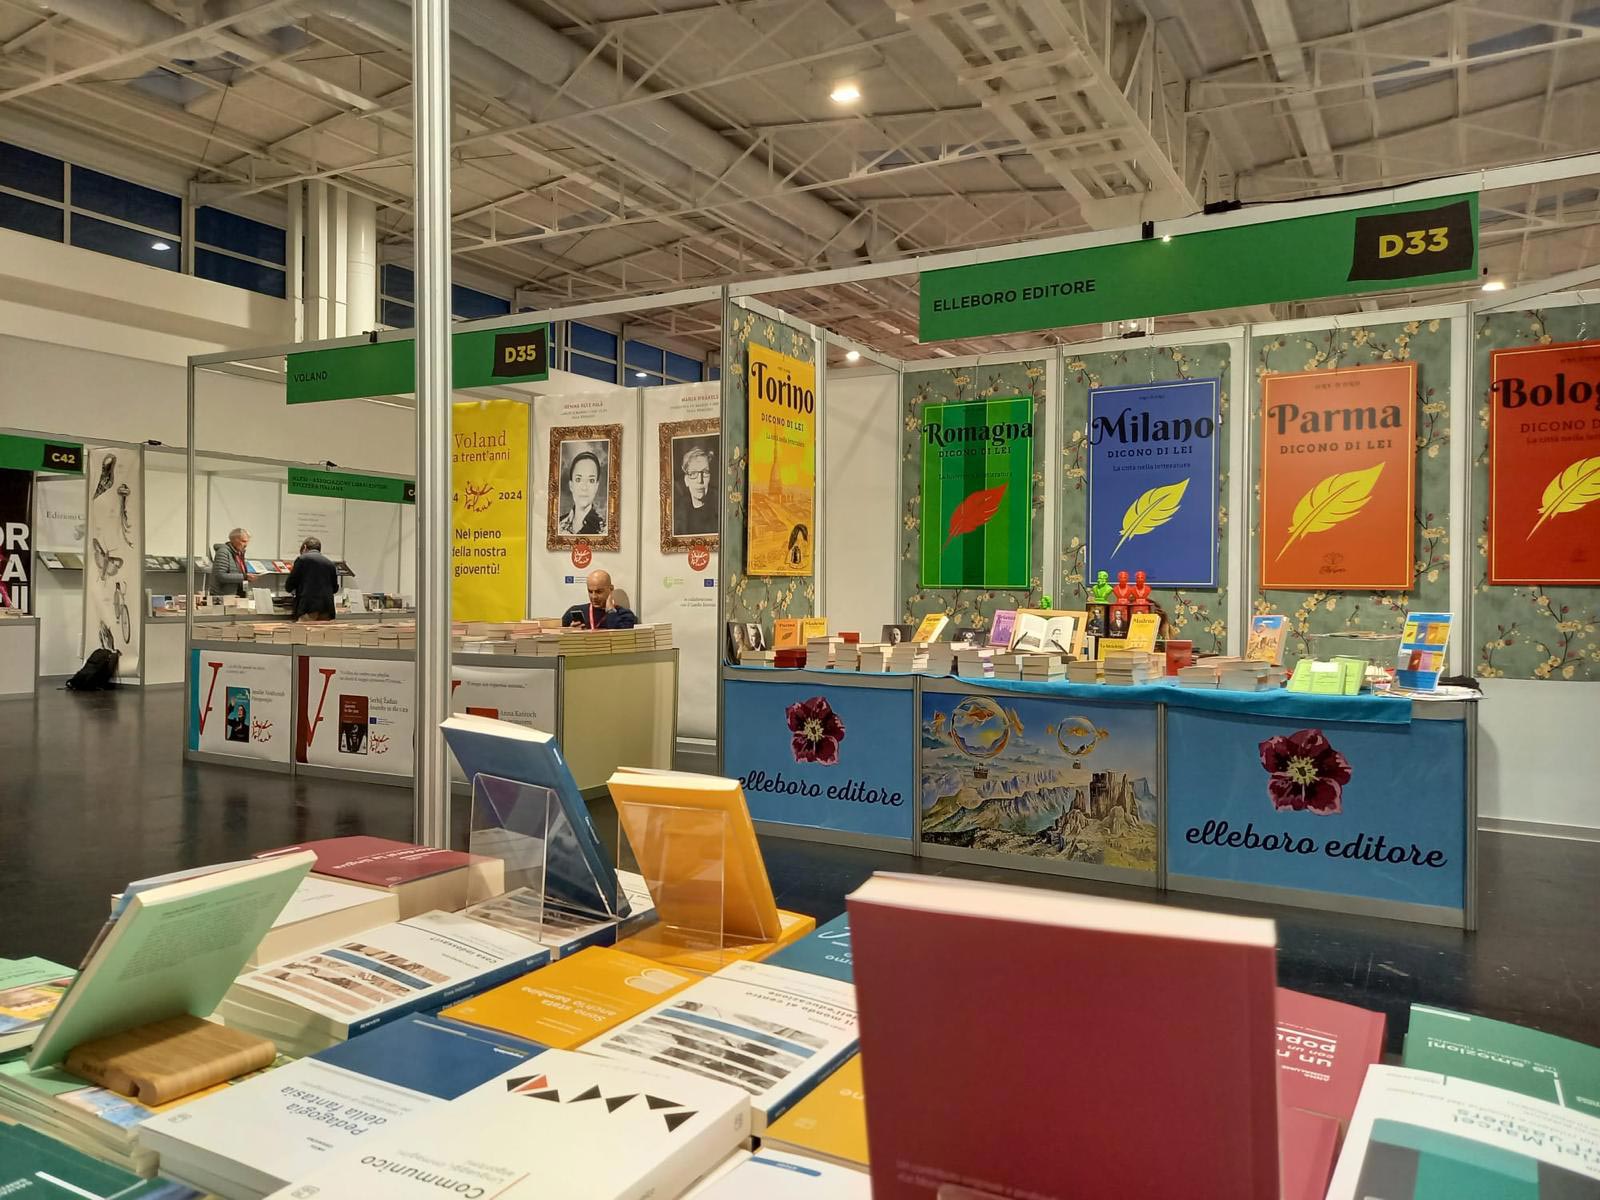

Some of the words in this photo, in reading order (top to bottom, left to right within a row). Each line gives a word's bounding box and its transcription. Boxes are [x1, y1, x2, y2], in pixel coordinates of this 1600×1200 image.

[1378, 226, 1449, 259] D33
[932, 289, 1017, 312] ELLEBORO
[1022, 279, 1096, 301] EDITORE
[505, 344, 536, 363] D35
[294, 370, 328, 383] VOLAND
[751, 361, 814, 414] Torino
[1490, 372, 1600, 411] Bolo
[761, 412, 785, 427] DICONO
[786, 419, 793, 429] DI
[794, 421, 804, 432] LEI
[1090, 408, 1214, 445] Milano
[1267, 403, 1403, 435] Parma
[1521, 420, 1585, 433] DICONO
[455, 430, 507, 449] Voland
[923, 422, 1033, 447] Romagna
[461, 448, 510, 462] trent'anni
[939, 448, 977, 457] DICONO
[994, 447, 1011, 455] LEI
[1107, 448, 1152, 458] DICONO
[1157, 447, 1168, 455] DI
[1173, 446, 1192, 454] LEI
[1280, 442, 1339, 455] DICONO
[1345, 441, 1360, 450] DI
[1367, 439, 1392, 449] LEI
[52, 453, 75, 464] C42
[499, 490, 522, 500] 2024
[0, 521, 30, 550] R
[455, 528, 471, 539] Nel
[473, 528, 502, 542] pieno
[474, 547, 507, 557] nostra
[455, 563, 500, 577] gioventù!
[738, 770, 823, 797] elleboro
[827, 780, 904, 807] editore
[1185, 819, 1318, 854] elleboro
[1324, 832, 1448, 868] editore
[1299, 1054, 1332, 1067] un
[1427, 1040, 1525, 1068] emozioni
[1532, 1065, 1559, 1078] Le
[281, 1086, 344, 1112] fantasia
[286, 1103, 369, 1135] Pedagogia
[344, 1108, 388, 1125] della
[360, 1155, 485, 1200] Communico
